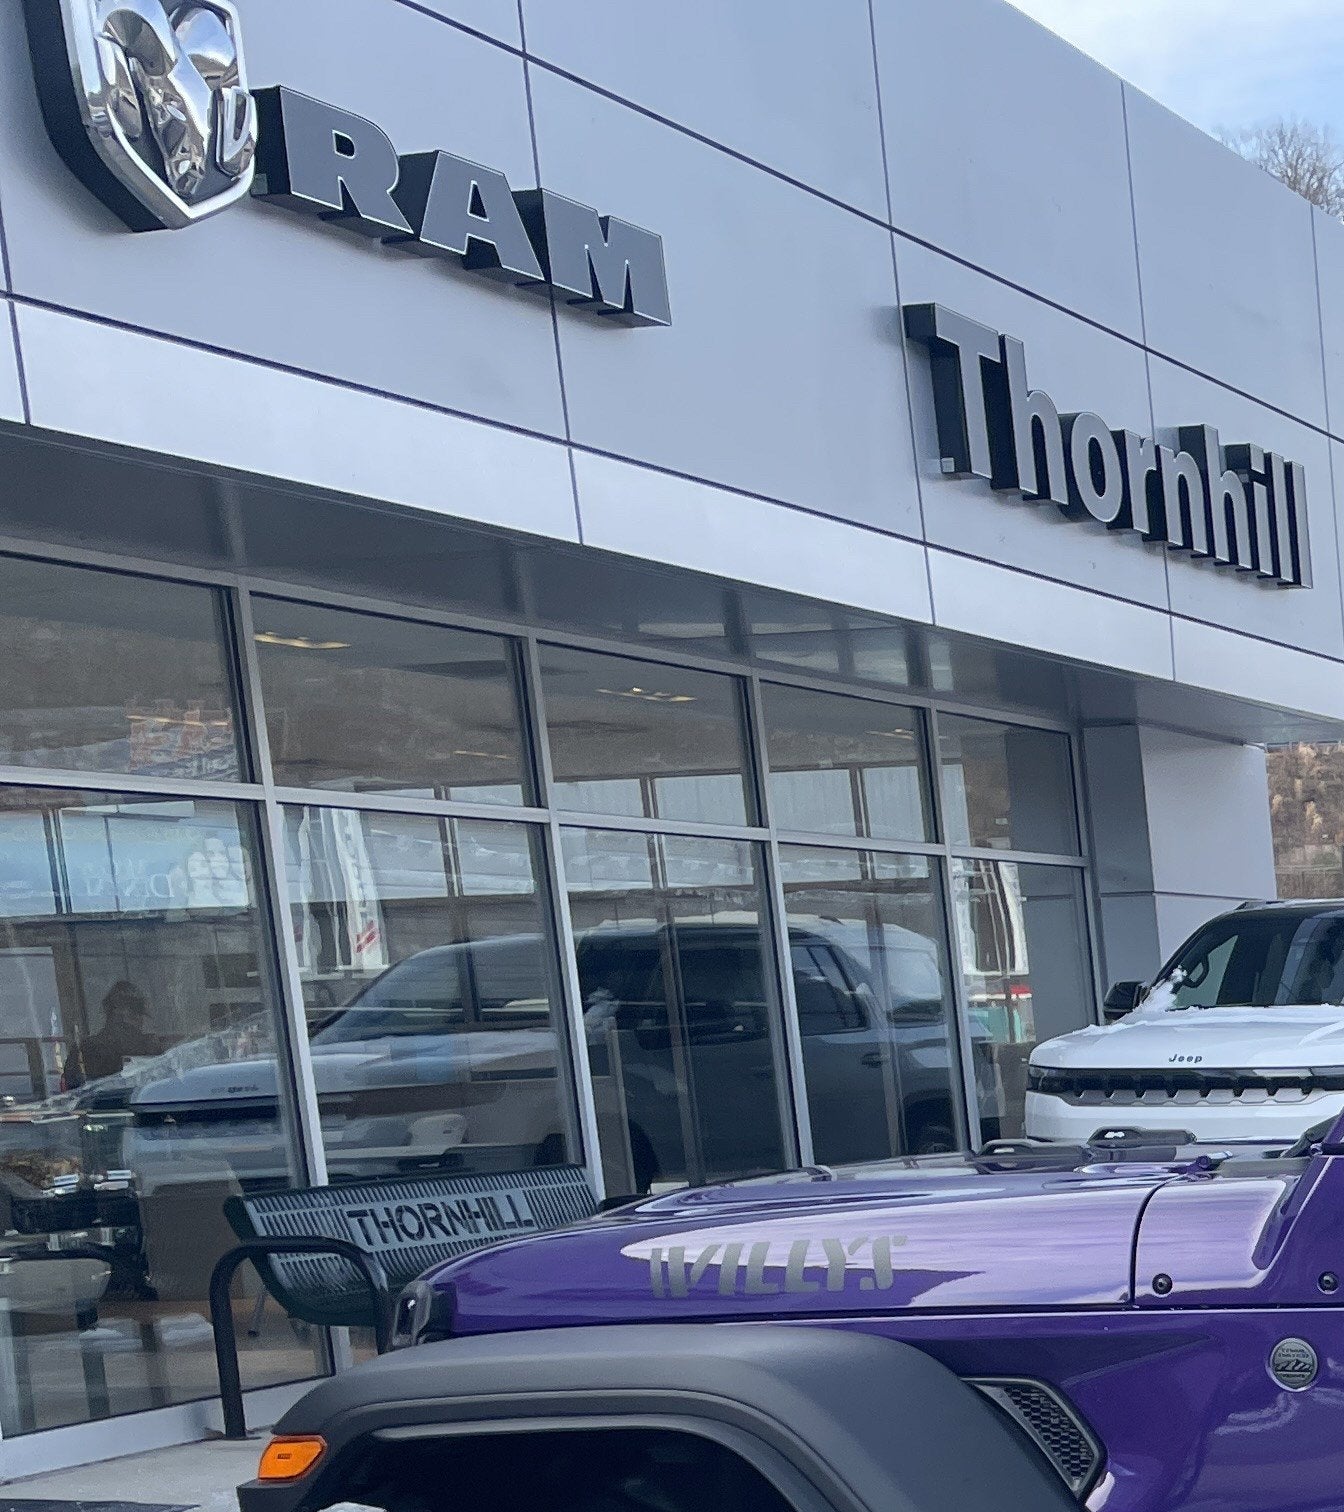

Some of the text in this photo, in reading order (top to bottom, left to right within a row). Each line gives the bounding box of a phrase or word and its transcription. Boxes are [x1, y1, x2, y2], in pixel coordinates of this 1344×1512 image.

[270, 85, 672, 327] RAM
[904, 302, 1313, 590] Thornhill
[1168, 1053, 1203, 1064] Jeep
[346, 1194, 535, 1247] THORNHILL
[650, 1235, 908, 1299] WILLYS
